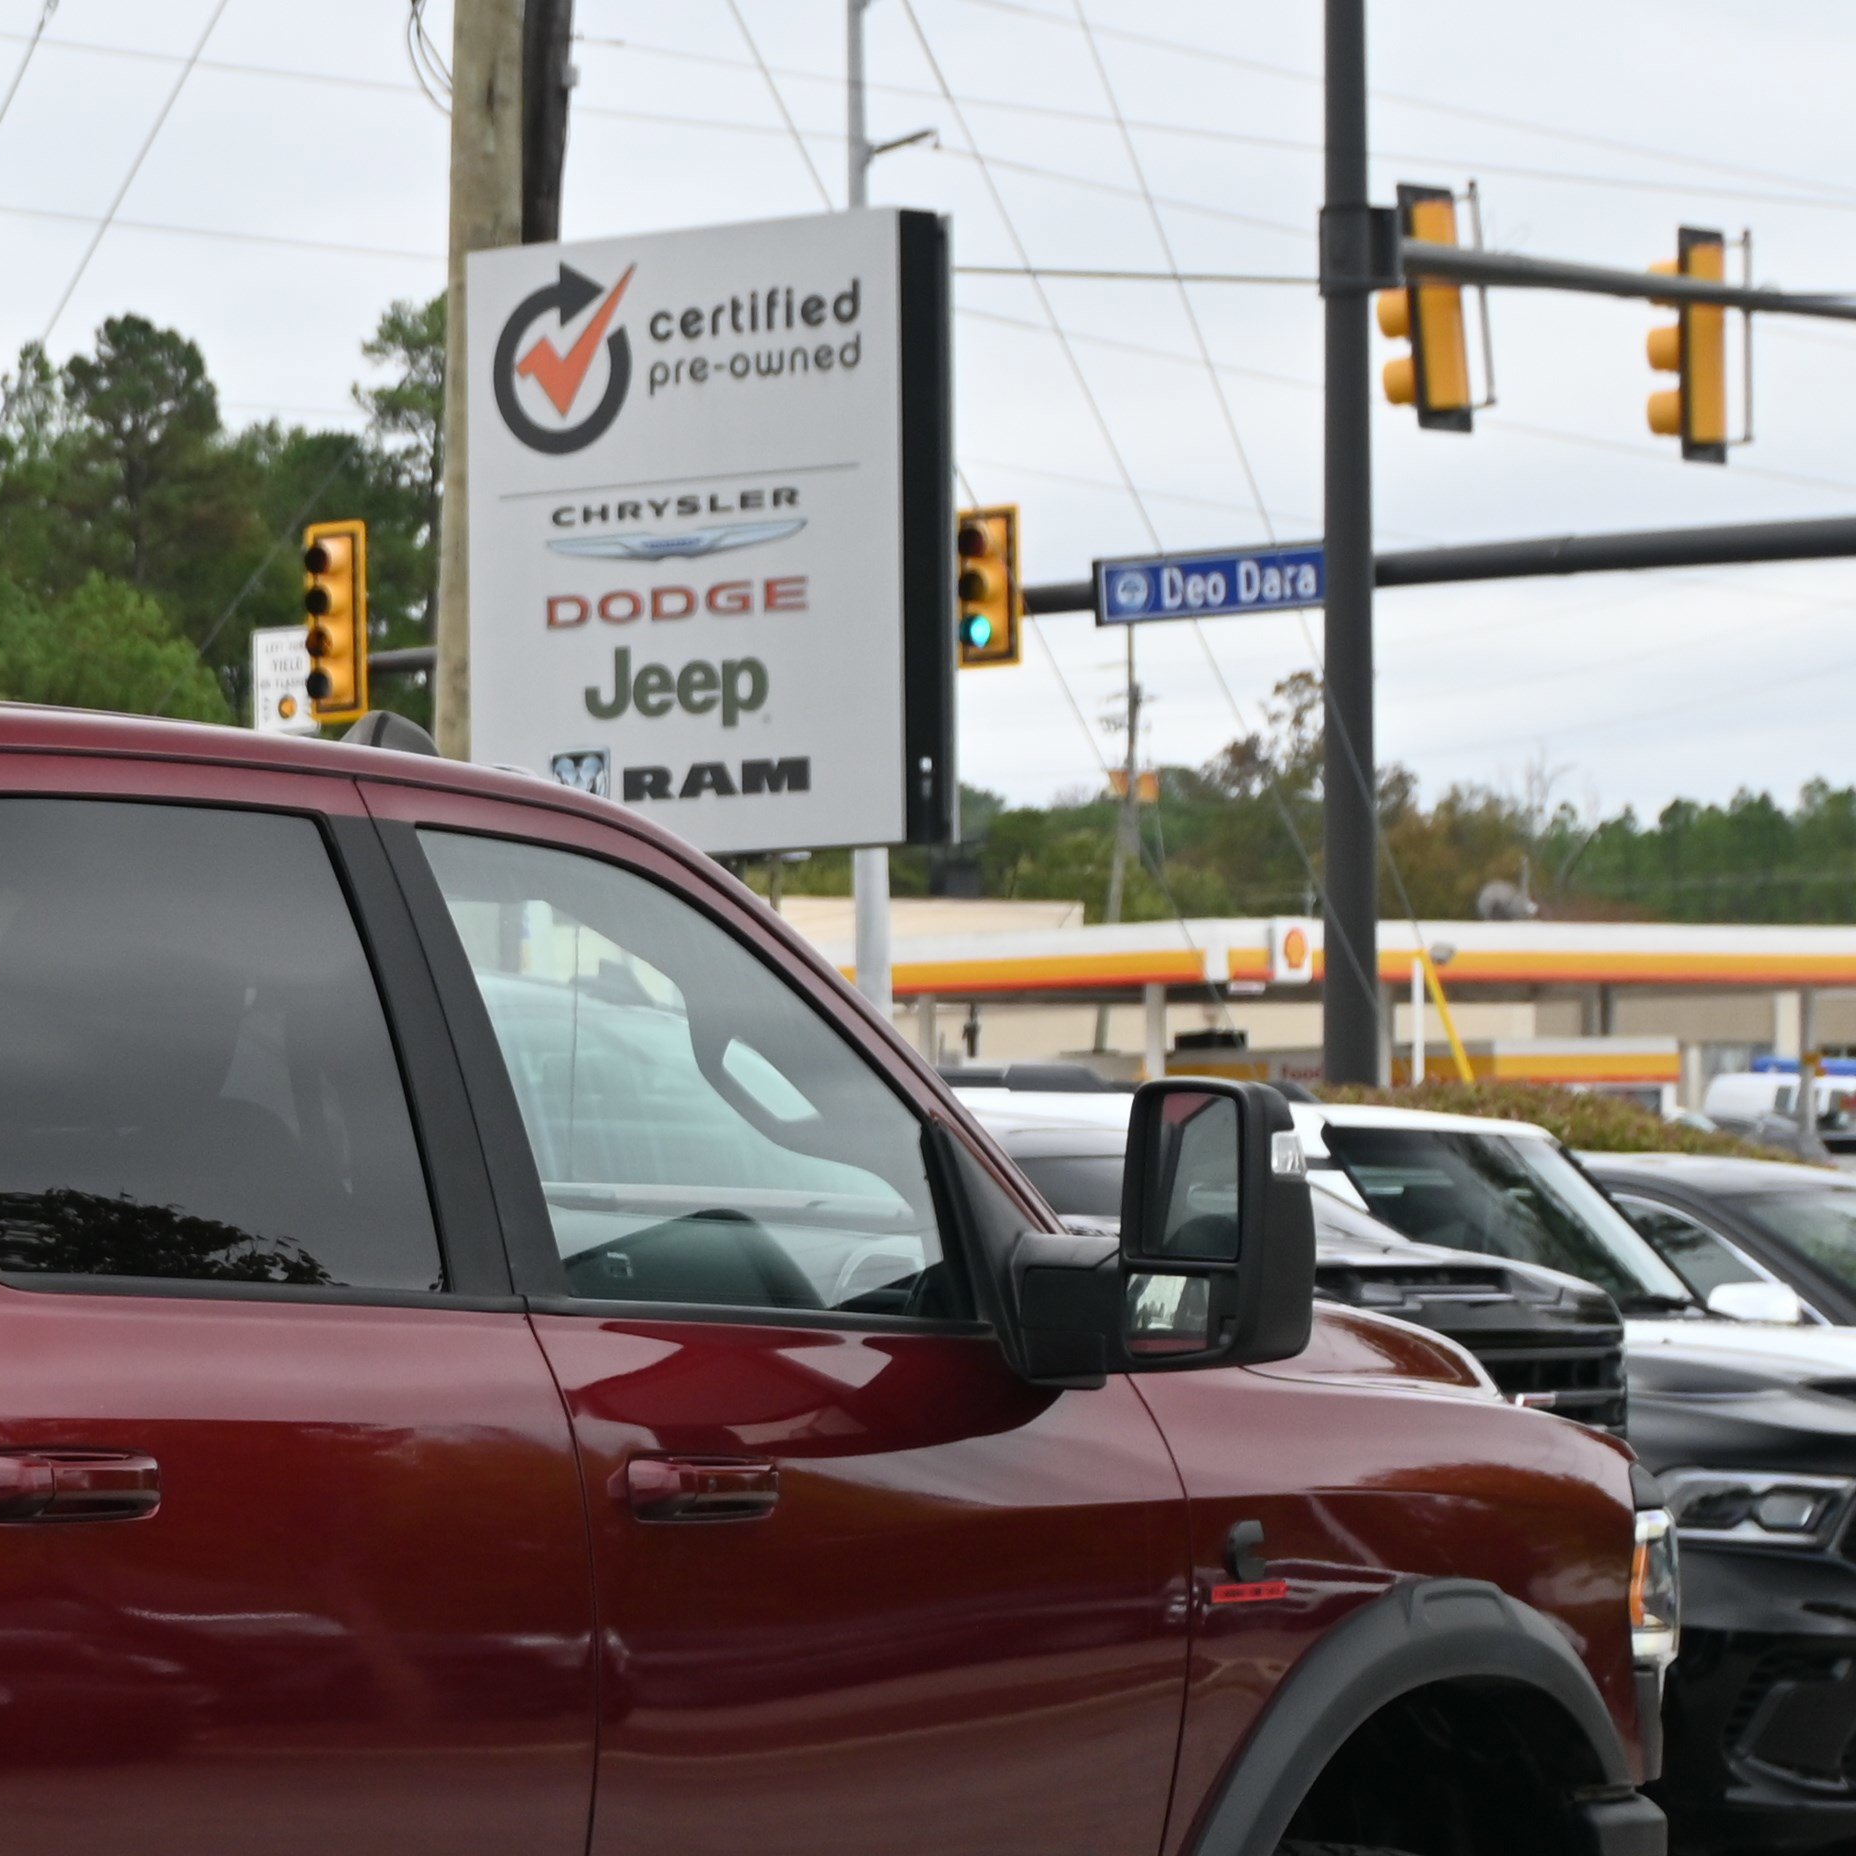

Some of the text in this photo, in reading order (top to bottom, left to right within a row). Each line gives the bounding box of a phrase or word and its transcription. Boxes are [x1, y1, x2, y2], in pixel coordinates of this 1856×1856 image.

[649, 277, 861, 343] certified
[649, 333, 861, 396] pre-owned
[551, 486, 800, 528] CHRYSLER
[546, 576, 810, 630] DODGE
[1160, 560, 1317, 609] Deo Dara
[272, 657, 303, 673] YIELD
[584, 646, 769, 728] Jeep
[622, 756, 810, 802] RAM
